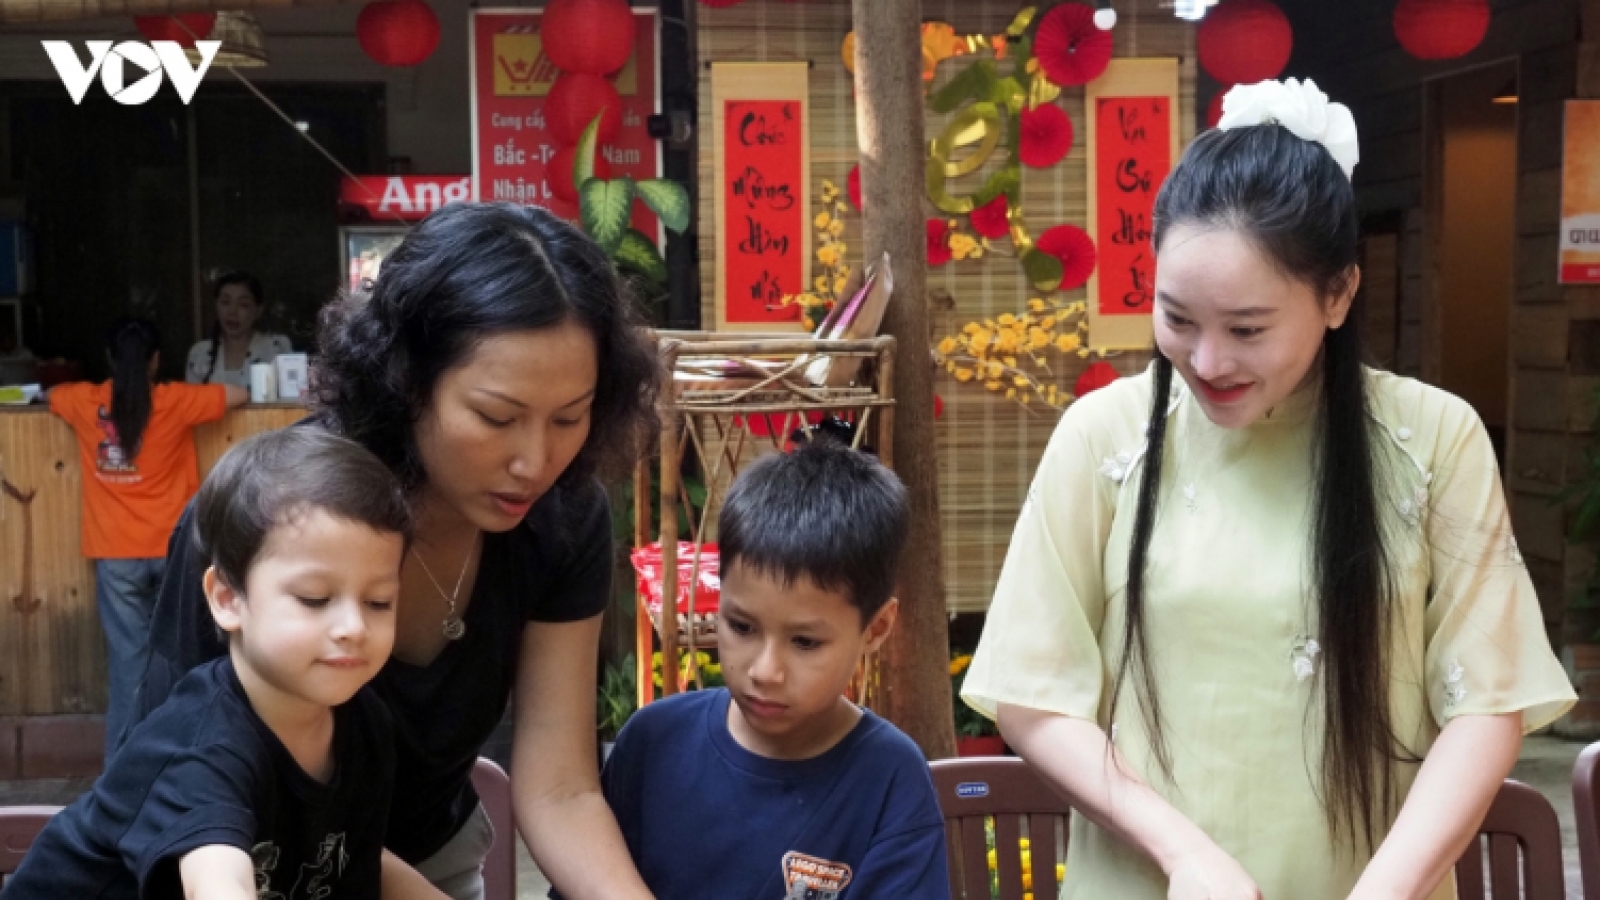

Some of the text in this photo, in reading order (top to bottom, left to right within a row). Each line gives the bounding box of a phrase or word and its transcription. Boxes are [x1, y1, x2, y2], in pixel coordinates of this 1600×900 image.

[491, 112, 522, 131] Cung
[493, 138, 526, 165] Bắc
[602, 145, 640, 164] Nam
